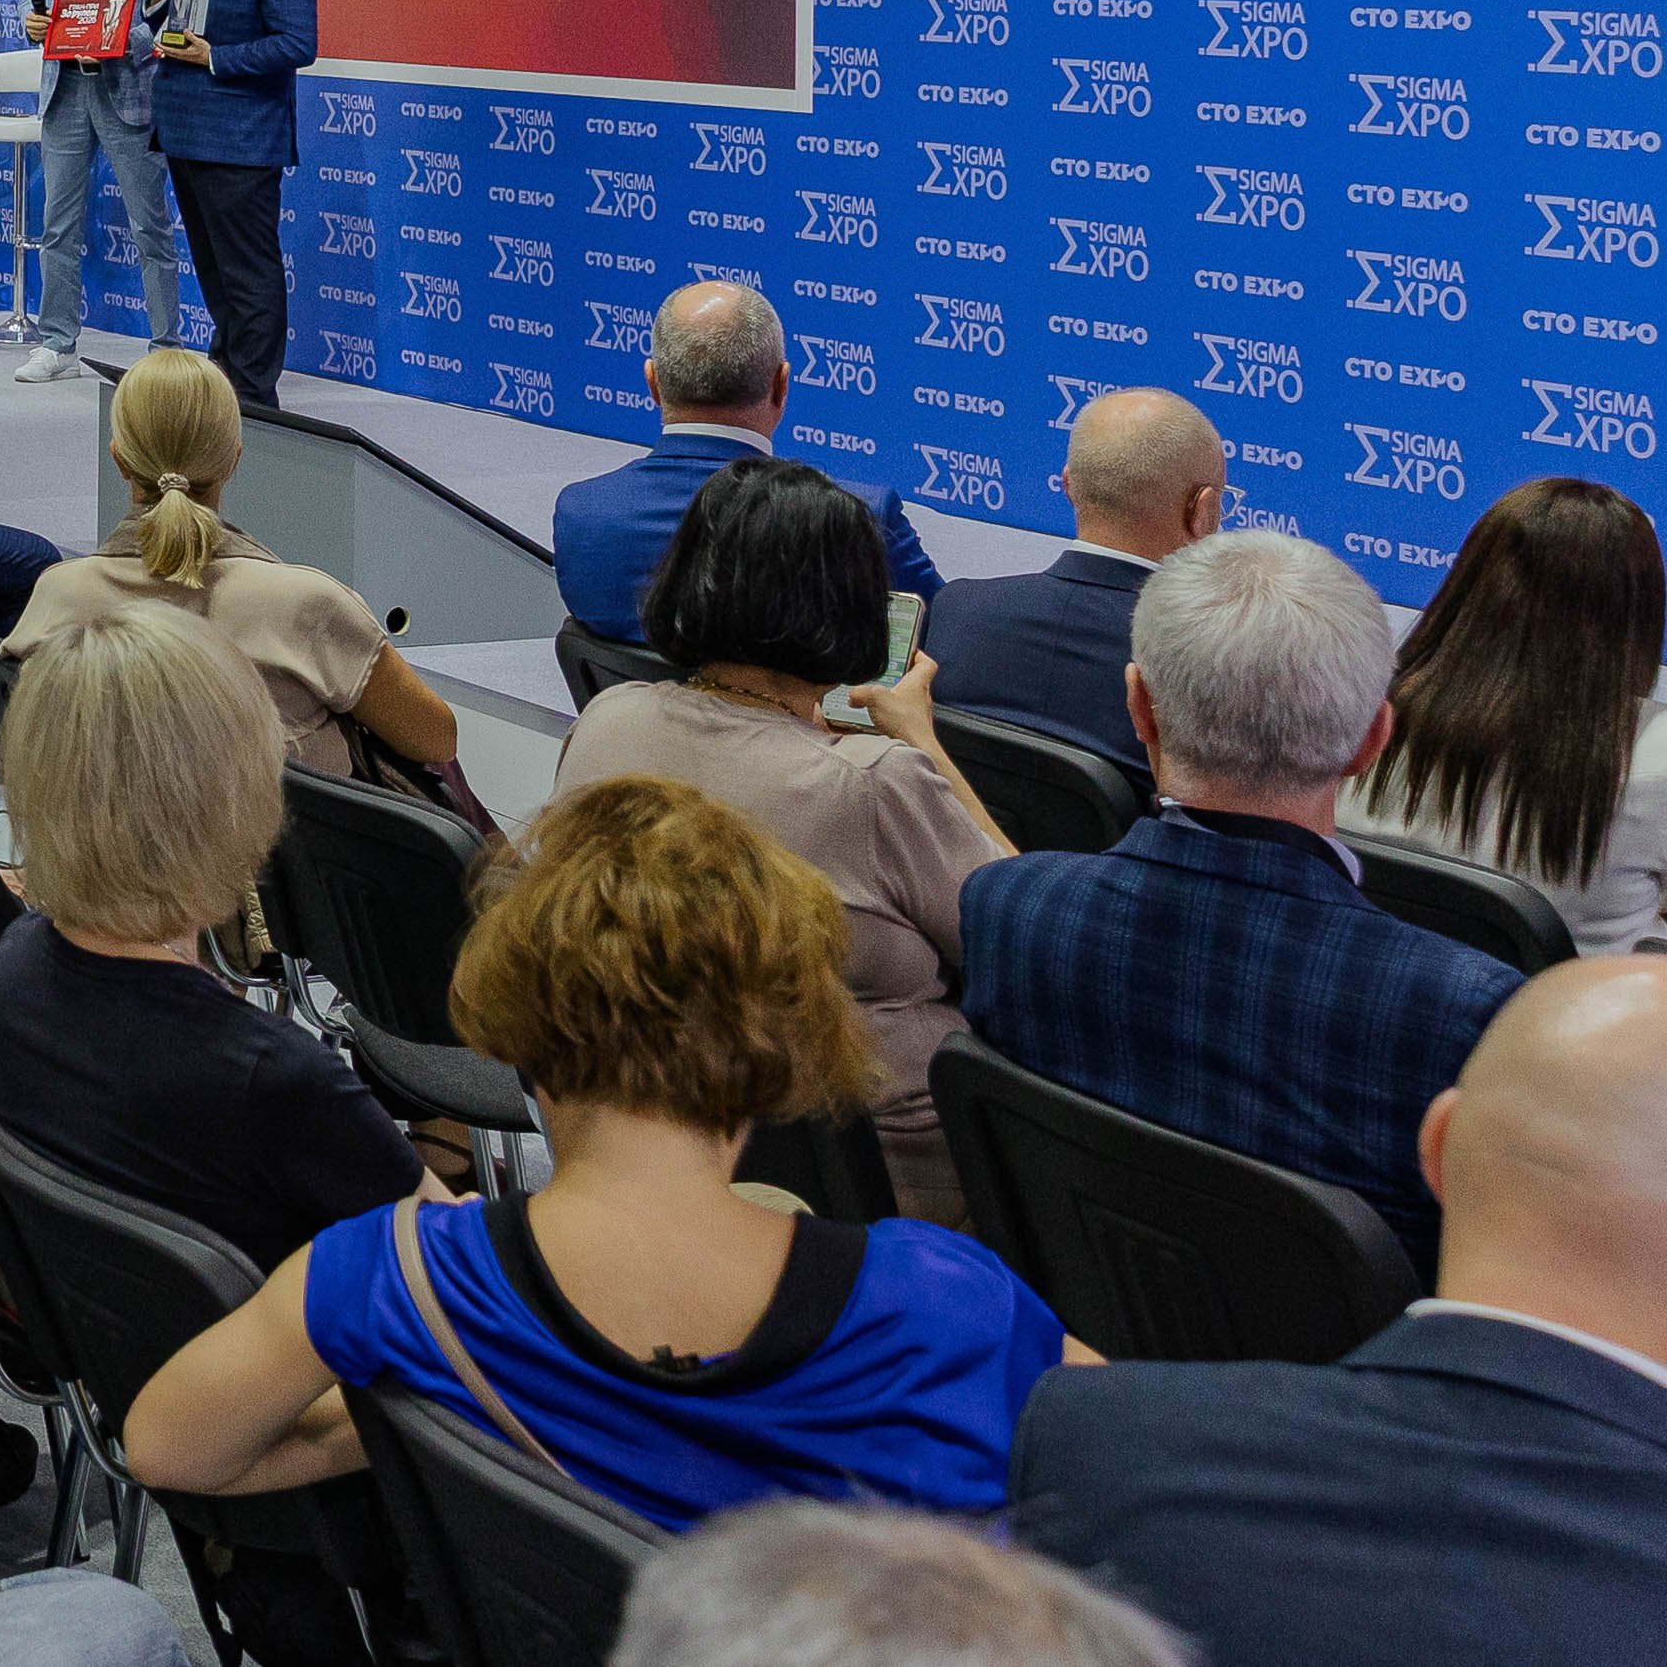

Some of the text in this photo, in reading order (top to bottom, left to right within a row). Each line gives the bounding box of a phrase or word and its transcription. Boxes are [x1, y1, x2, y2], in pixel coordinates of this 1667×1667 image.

[1247, 106, 1305, 126] EXPO
[620, 122, 656, 136] EXPO
[835, 140, 878, 157] EXPO
[1588, 129, 1660, 151] EXPO
[830, 195, 875, 215] SIGMA
[1403, 189, 1467, 211] EXPO
[1245, 276, 1303, 299] EXPO
[1400, 366, 1465, 390] EXPO
[956, 395, 1003, 416] EXPO
[1578, 387, 1652, 418] SIGMA
